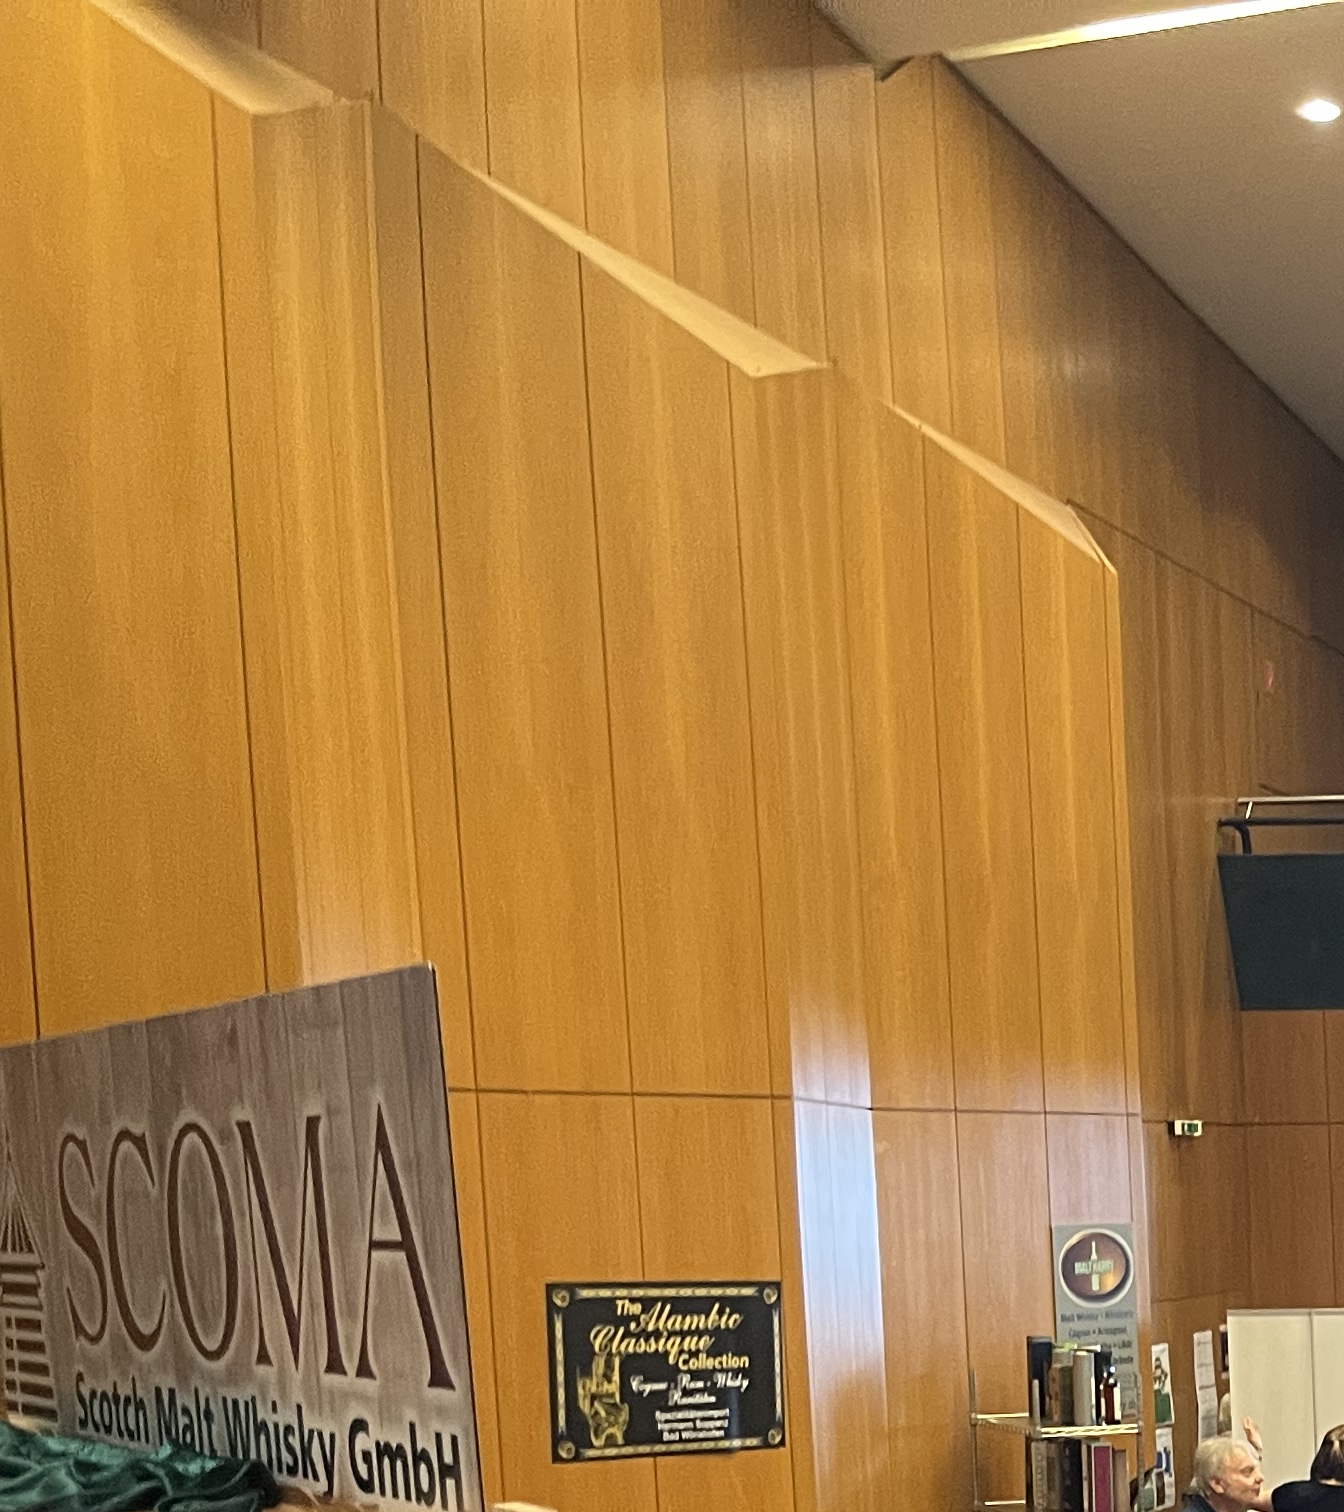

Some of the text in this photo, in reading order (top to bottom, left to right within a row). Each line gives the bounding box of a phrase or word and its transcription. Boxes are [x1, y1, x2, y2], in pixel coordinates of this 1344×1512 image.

[59, 1103, 455, 1390] SCOMA
[616, 1299, 642, 1316] The
[630, 1301, 743, 1333] Alambic
[590, 1324, 715, 1365] Classique
[678, 1352, 749, 1371] Collection
[76, 1371, 463, 1512] Scotch Malt Whisky GmbH
